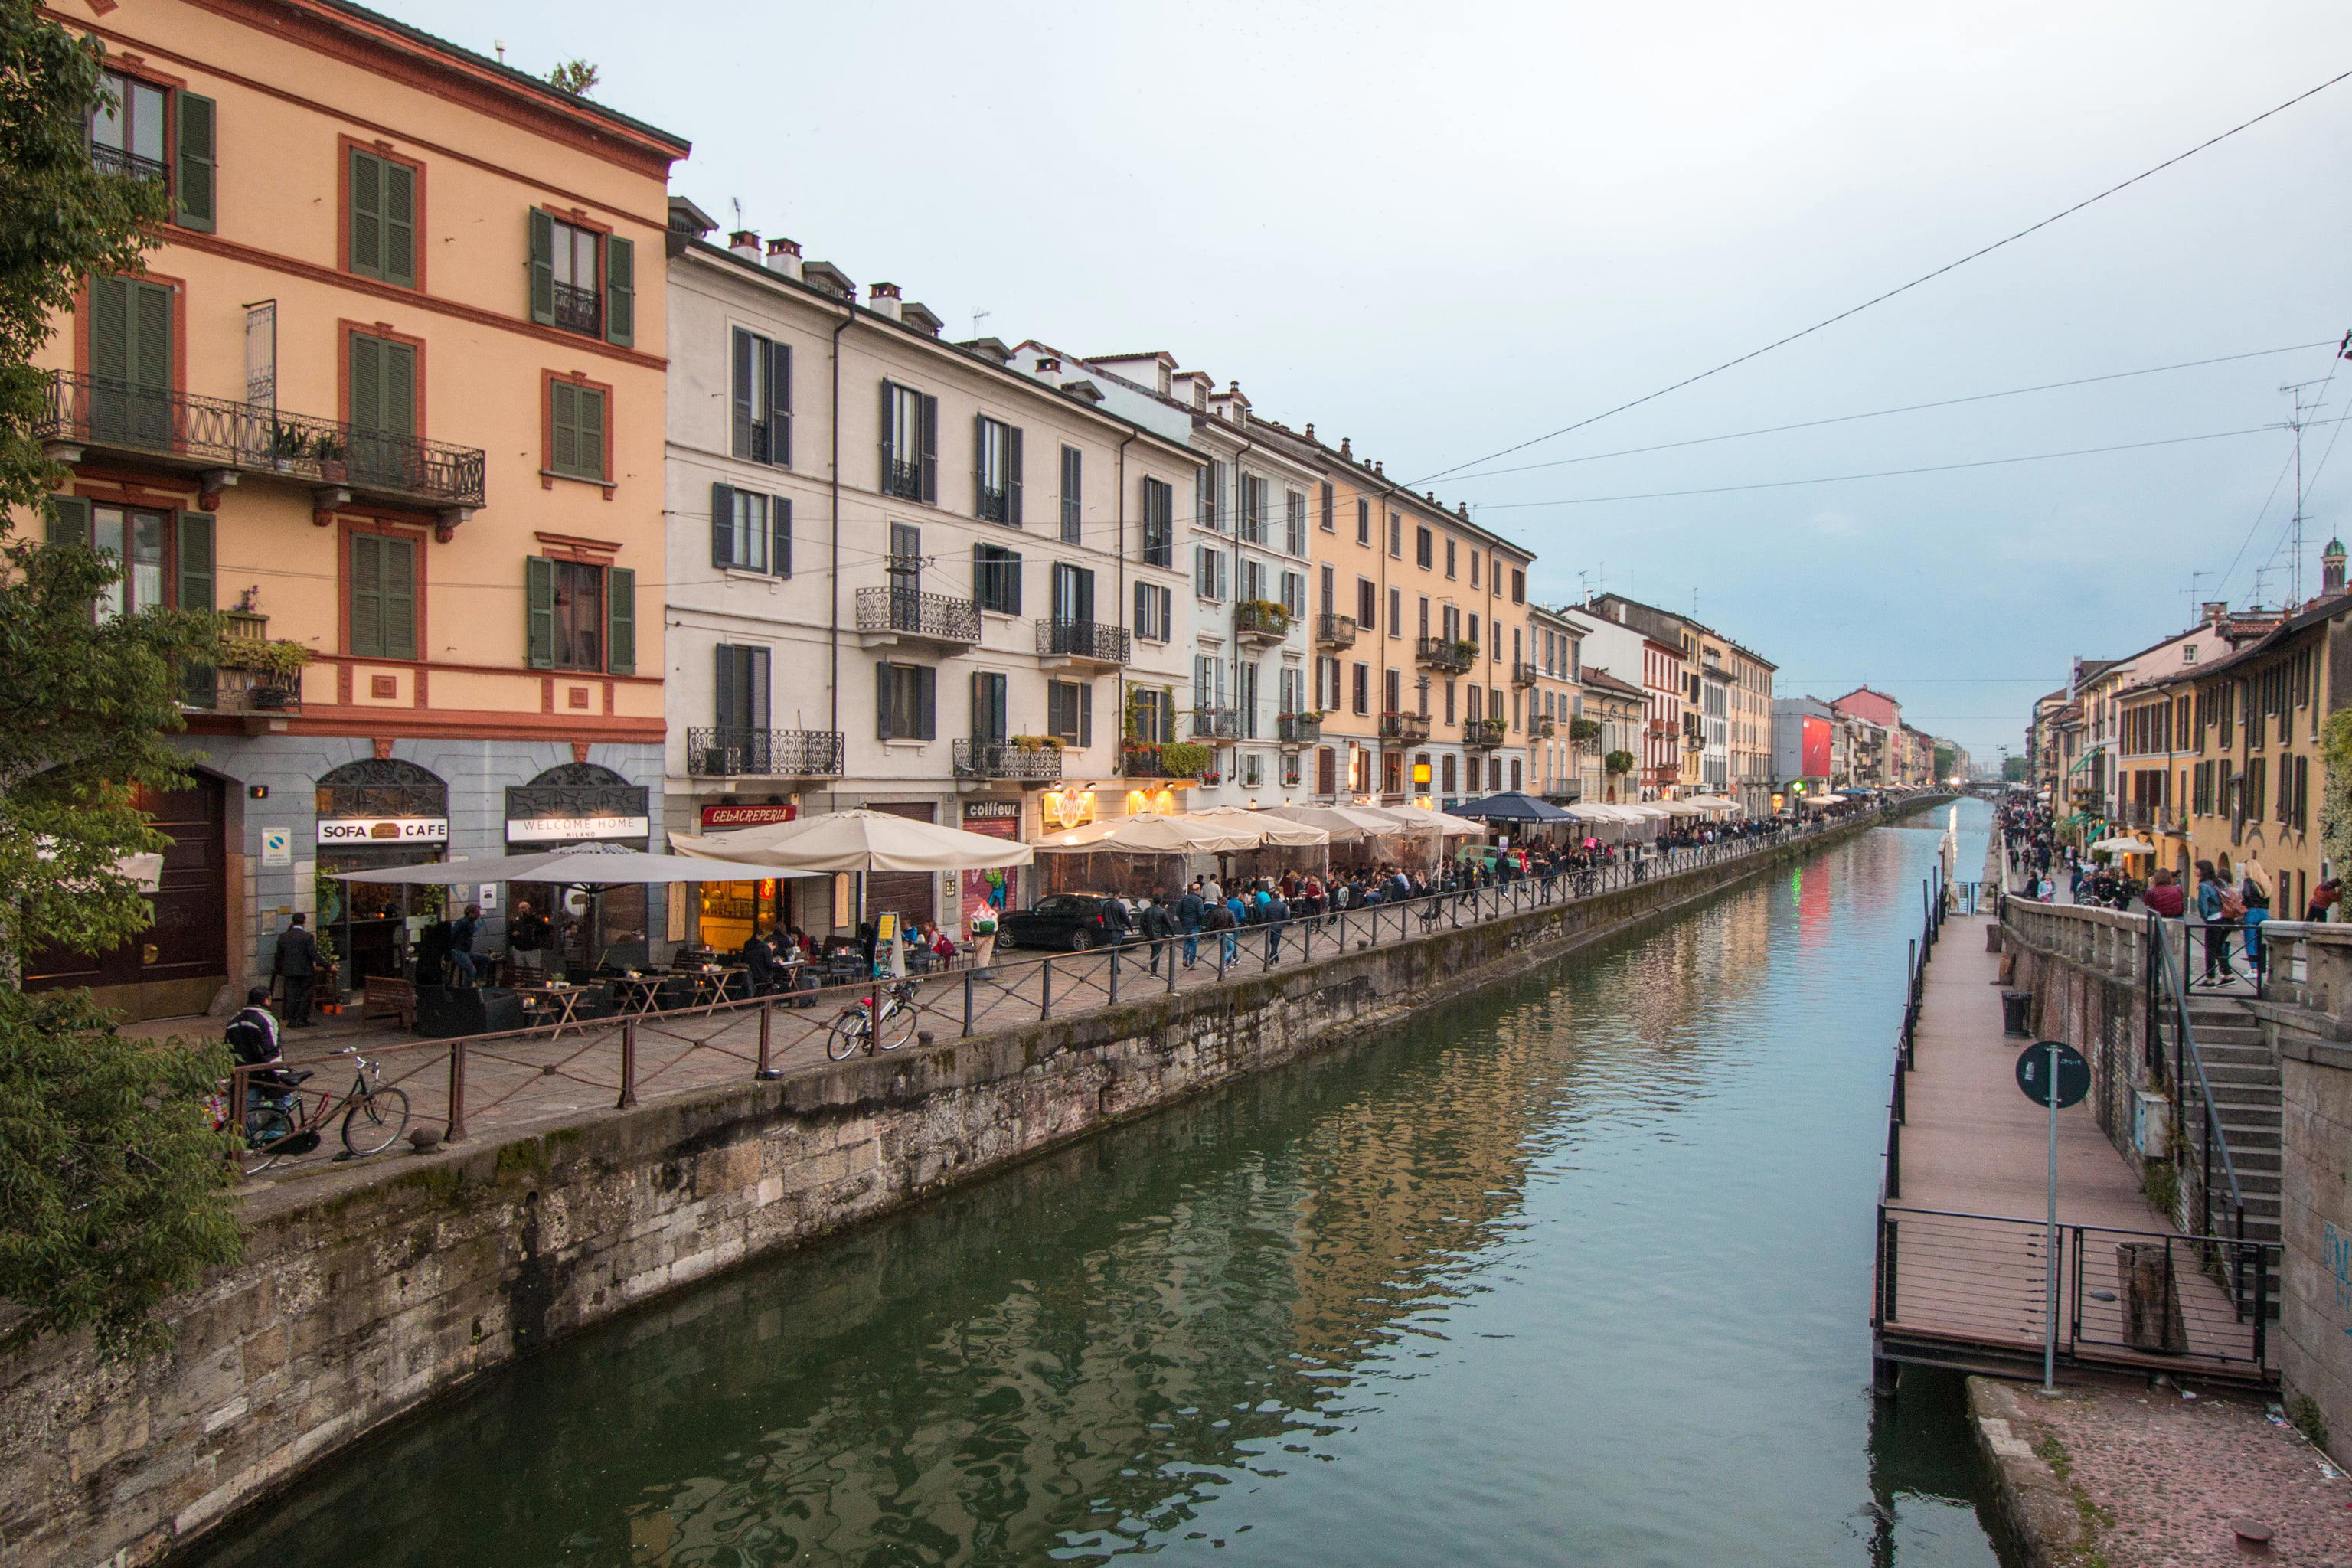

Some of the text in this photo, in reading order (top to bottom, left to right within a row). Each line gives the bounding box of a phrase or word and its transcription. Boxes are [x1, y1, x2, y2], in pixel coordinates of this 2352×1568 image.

[712, 809, 787, 822] GELACREPERIA
[969, 802, 1017, 816] coiffeur
[524, 818, 635, 830] WELCOME HOME
[323, 825, 446, 838] SOFA CAFE
